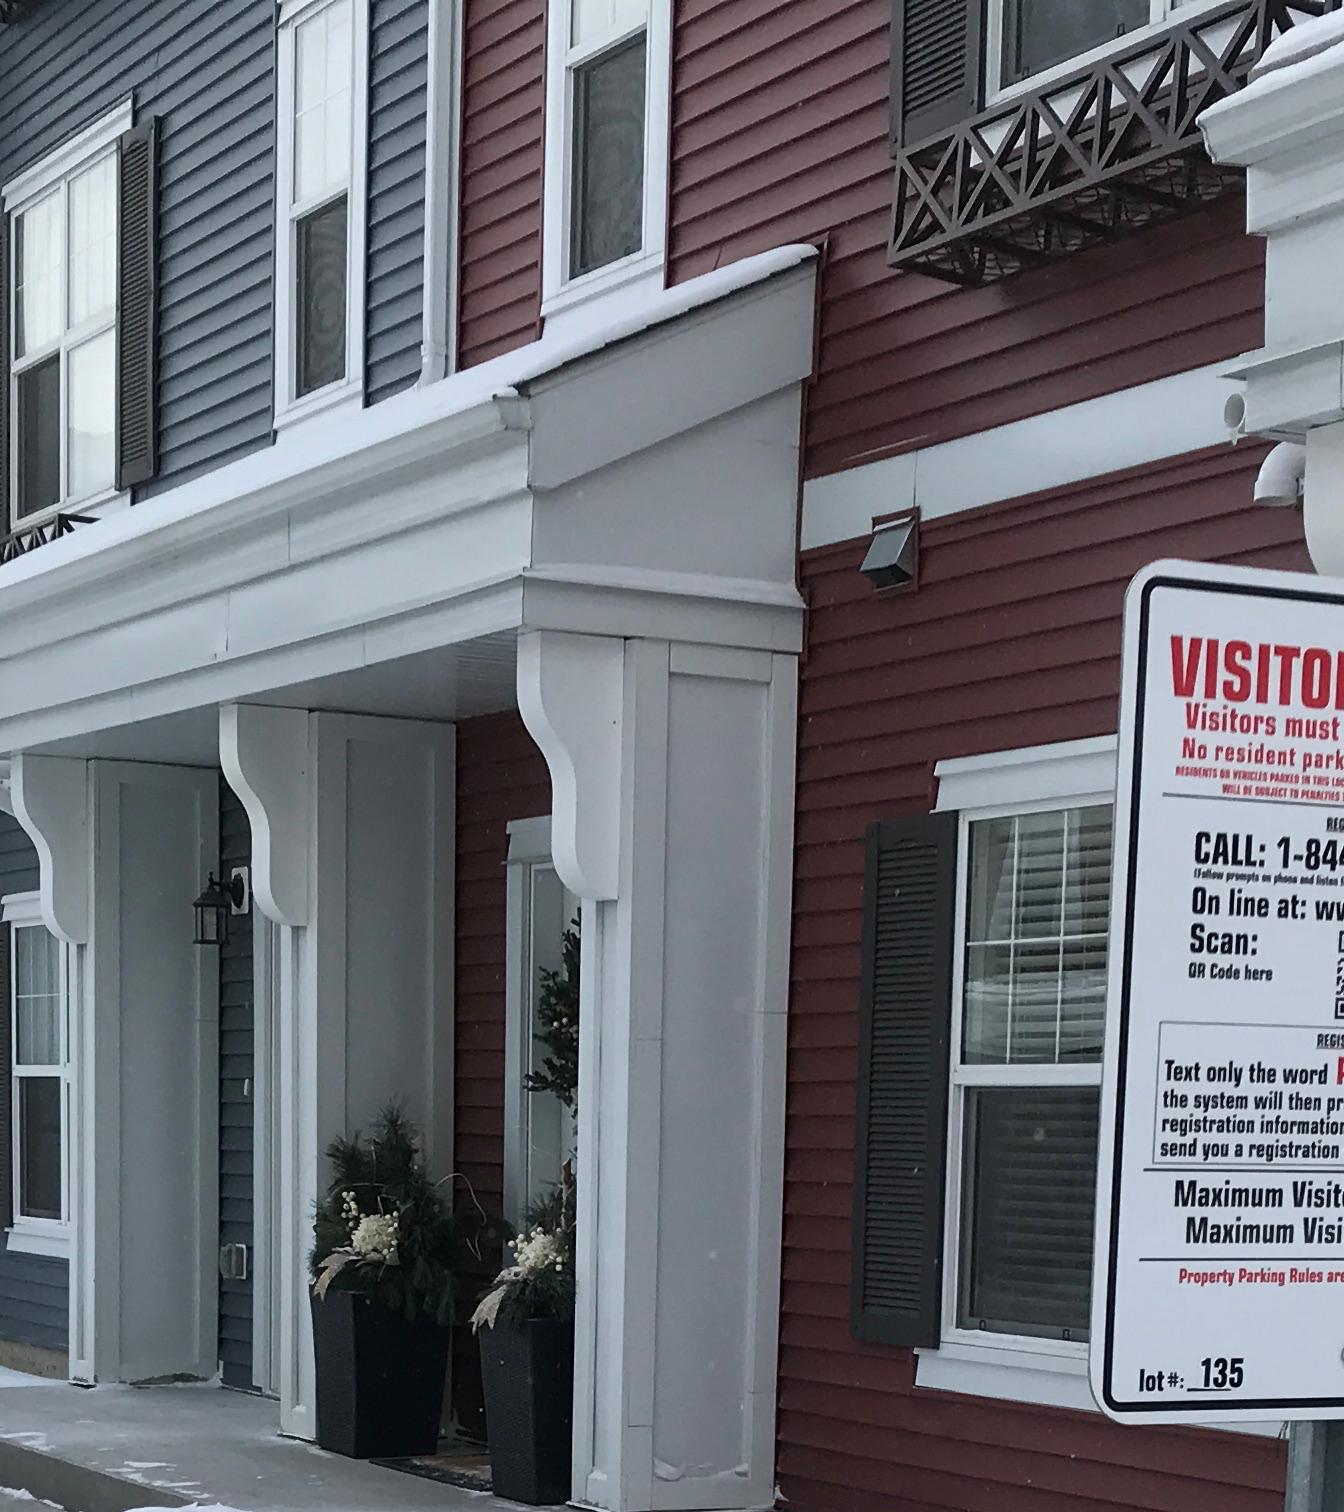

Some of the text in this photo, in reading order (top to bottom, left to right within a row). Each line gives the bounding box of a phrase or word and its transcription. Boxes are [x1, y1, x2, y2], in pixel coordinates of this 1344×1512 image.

[1185, 702, 1276, 736] Visitors
[1284, 716, 1340, 741] must
[1182, 736, 1207, 760] No
[1214, 741, 1296, 767] resident
[1194, 831, 1266, 869] CALL:
[1191, 886, 1220, 915] On
[1228, 887, 1269, 918] line
[1276, 893, 1306, 920] at:
[1189, 922, 1258, 956] Scan:
[1188, 961, 1273, 981] QR Code here
[1164, 1059, 1201, 1082] Text
[1206, 1060, 1243, 1088] only
[1248, 1061, 1276, 1084] the
[1282, 1062, 1328, 1085] word
[1162, 1088, 1188, 1109] the
[1193, 1087, 1248, 1112] system
[1253, 1090, 1283, 1110] will
[1287, 1090, 1321, 1111] then
[1161, 1112, 1255, 1136] registration
[1160, 1138, 1197, 1157] send
[1202, 1143, 1230, 1161] you
[1234, 1143, 1243, 1157] a
[1248, 1138, 1339, 1162] registration
[1174, 1179, 1283, 1208] Maximum
[1185, 1215, 1294, 1244] Maximum
[1178, 1268, 1235, 1287] Property
[1238, 1266, 1285, 1286] Parking
[1289, 1266, 1323, 1283] Rules
[1138, 1368, 1165, 1392] lot
[1200, 1358, 1244, 1387] 135
